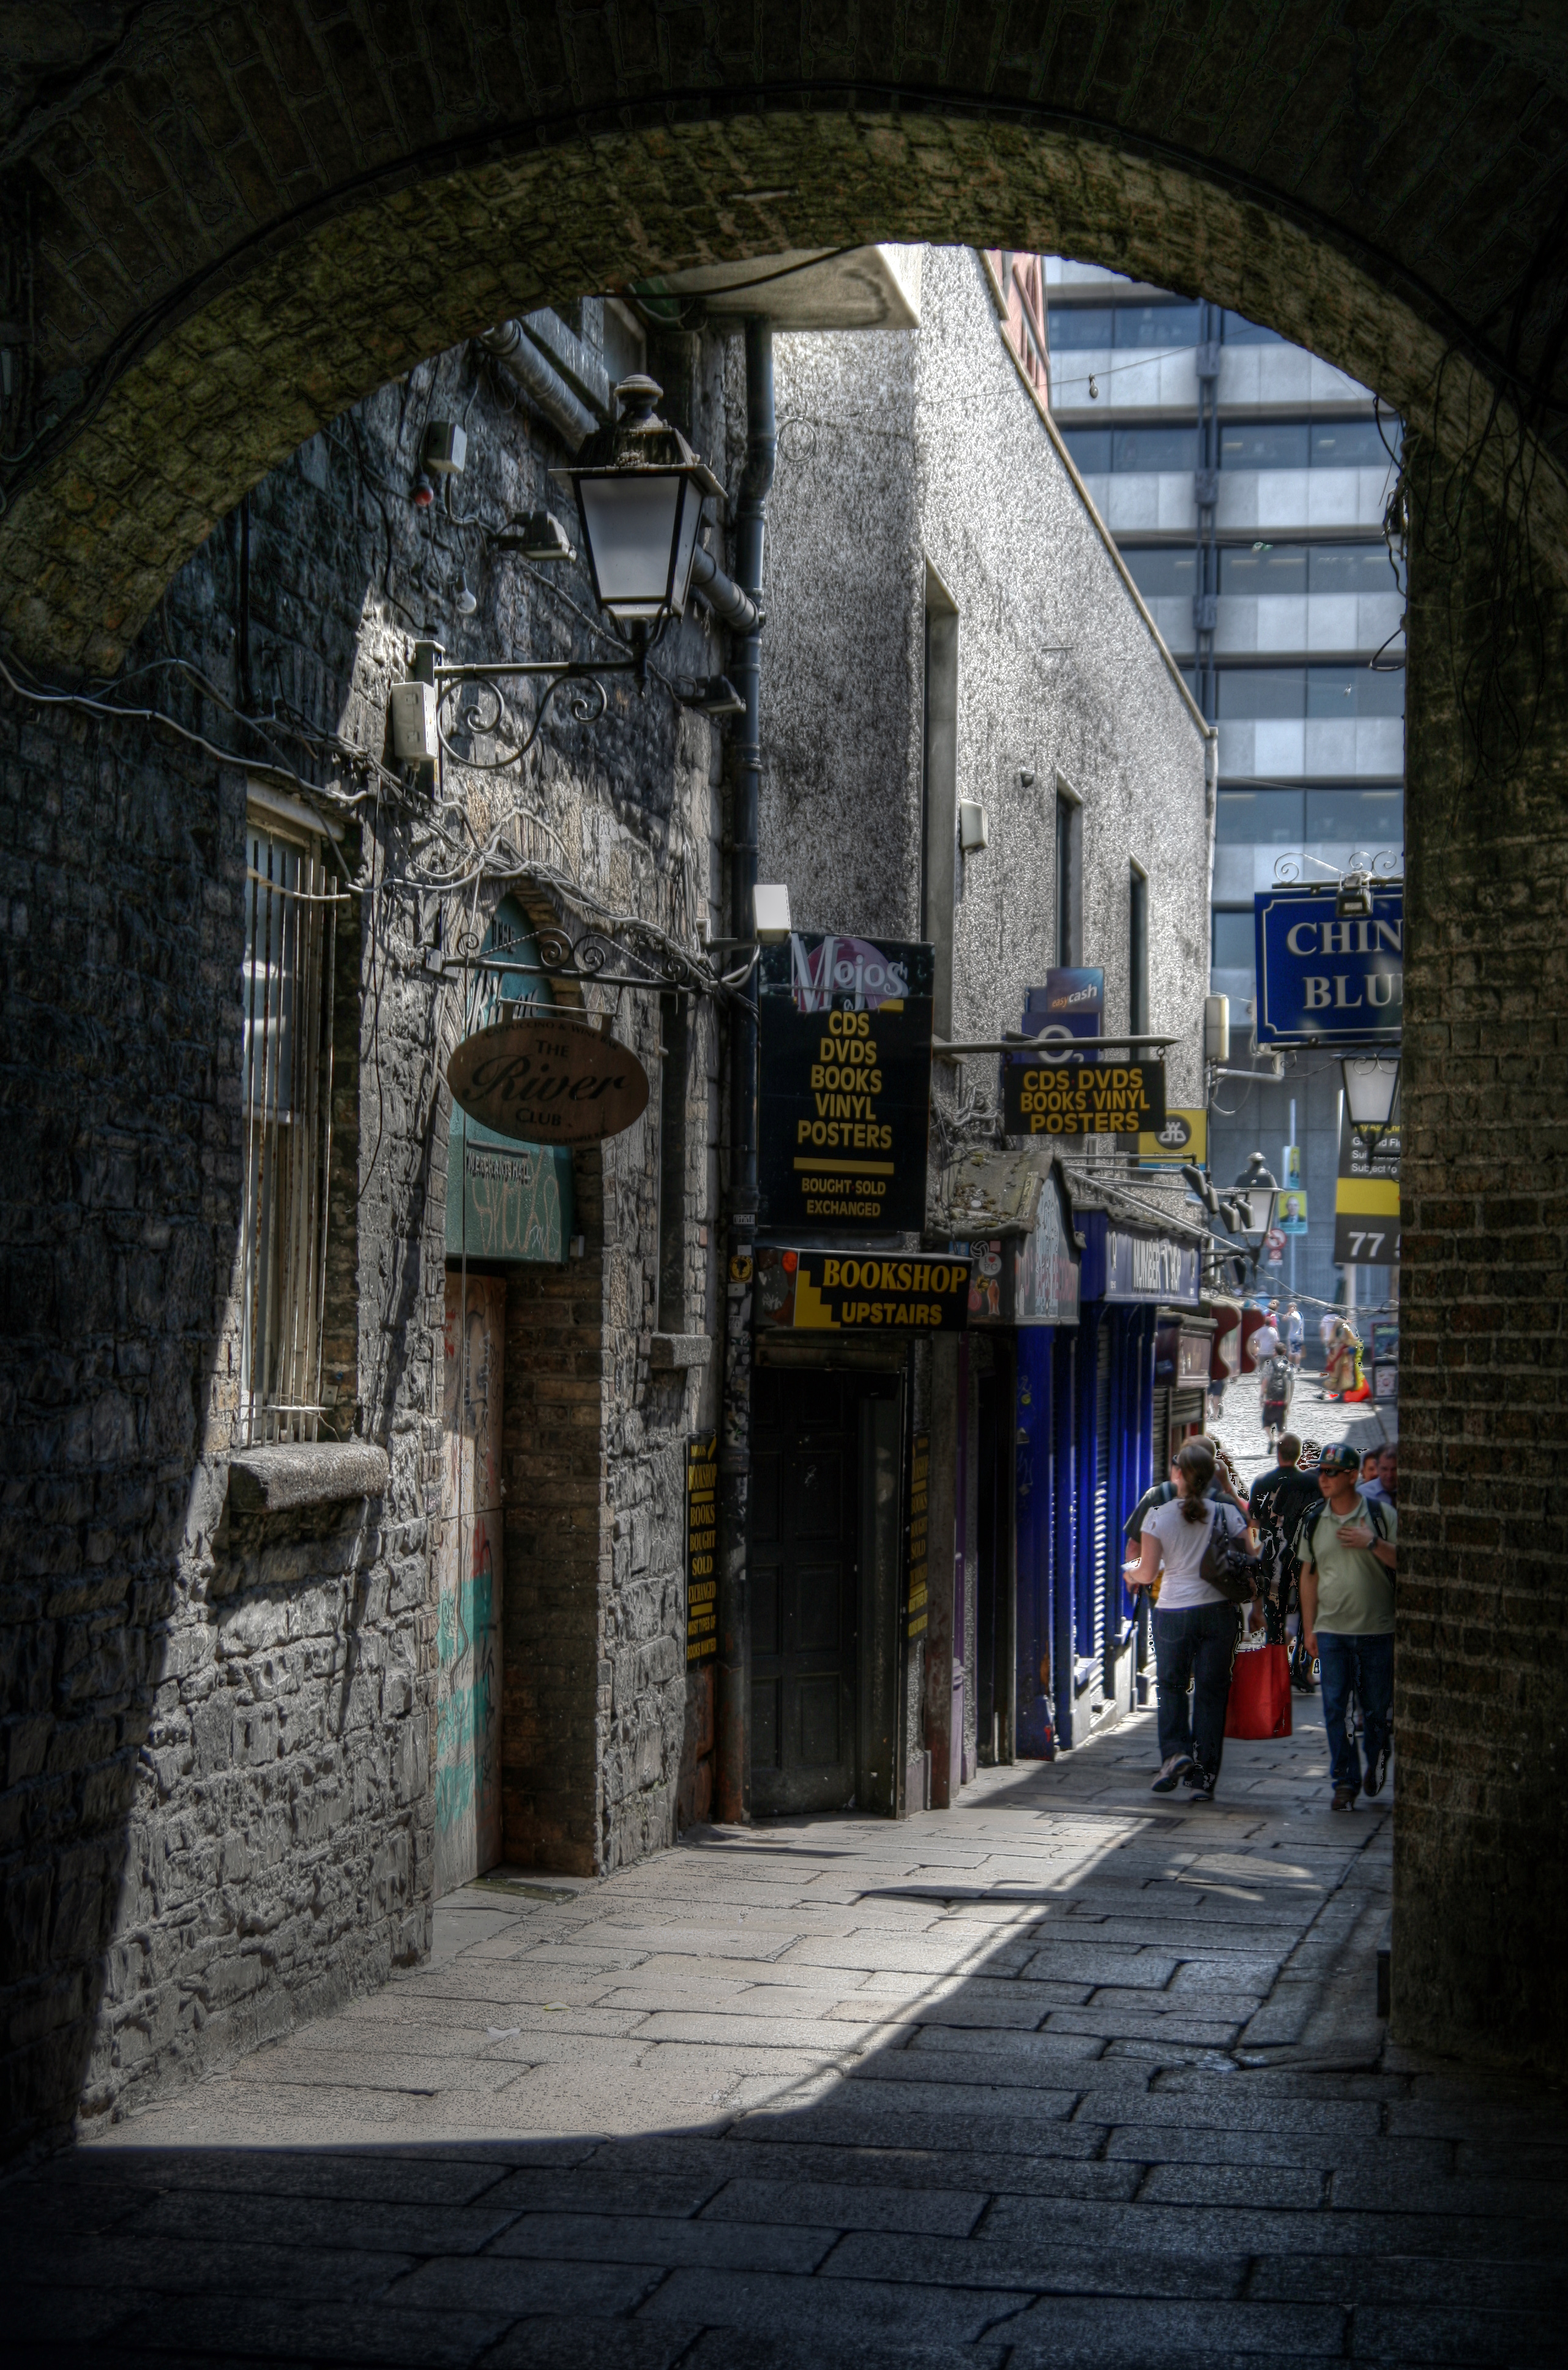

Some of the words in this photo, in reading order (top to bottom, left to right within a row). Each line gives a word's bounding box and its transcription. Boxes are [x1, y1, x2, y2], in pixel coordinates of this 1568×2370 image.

[791, 933, 908, 1011] Mojos
[1052, 983, 1097, 1007] easycash
[1302, 973, 1403, 1009] BLU
[485, 1020, 554, 1037] CAPPUCCINO
[829, 1011, 870, 1037] CDS
[536, 1039, 569, 1057] THE
[820, 1037, 877, 1066] DVDS
[462, 1053, 630, 1102] River
[811, 1064, 882, 1094] BOOKS
[1023, 1069, 1070, 1091] CDS
[1078, 1067, 1143, 1090] DVDS
[815, 1093, 876, 1121] VINYL
[1020, 1091, 1086, 1113] BOOKS
[1092, 1090, 1150, 1111] VINYL
[516, 1107, 561, 1126] CLUB
[1031, 1111, 1139, 1134] POSTERS
[797, 1120, 892, 1149] POSTERS
[801, 1177, 852, 1194] BOUGHT
[855, 1179, 886, 1197] SOLD
[807, 1198, 881, 1217] EXCHANGED
[1348, 1232, 1385, 1257] 77
[823, 1259, 967, 1294] BOOKSHOP
[984, 1263, 998, 1271] FC
[842, 1301, 943, 1326] UPSTAIRS
[688, 1463, 717, 1490] BOOKSHOP
[690, 1504, 715, 1527] BOOKS
[689, 1530, 716, 1552] BOUGHT
[692, 1555, 713, 1576] SOLD
[688, 1580, 716, 1604] EXCHANGED
